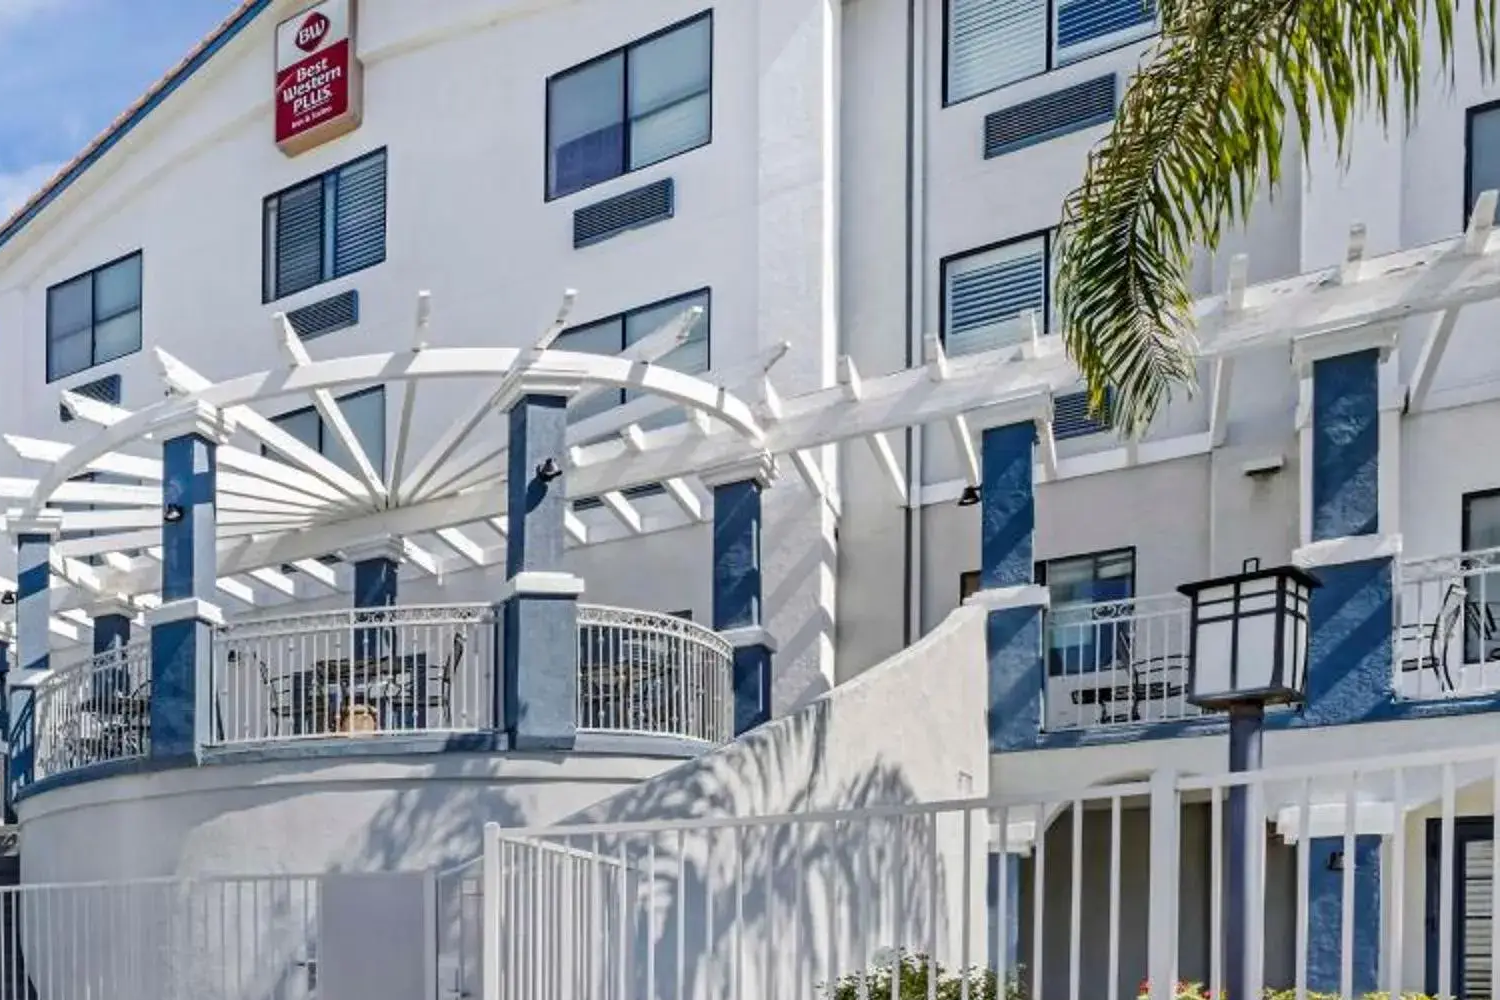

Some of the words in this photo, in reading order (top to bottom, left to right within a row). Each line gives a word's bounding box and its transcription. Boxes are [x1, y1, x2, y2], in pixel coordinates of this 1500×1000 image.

[299, 19, 325, 45] BW
[297, 58, 328, 82] Best
[283, 66, 341, 103] Western
[293, 84, 332, 114] PLUS
